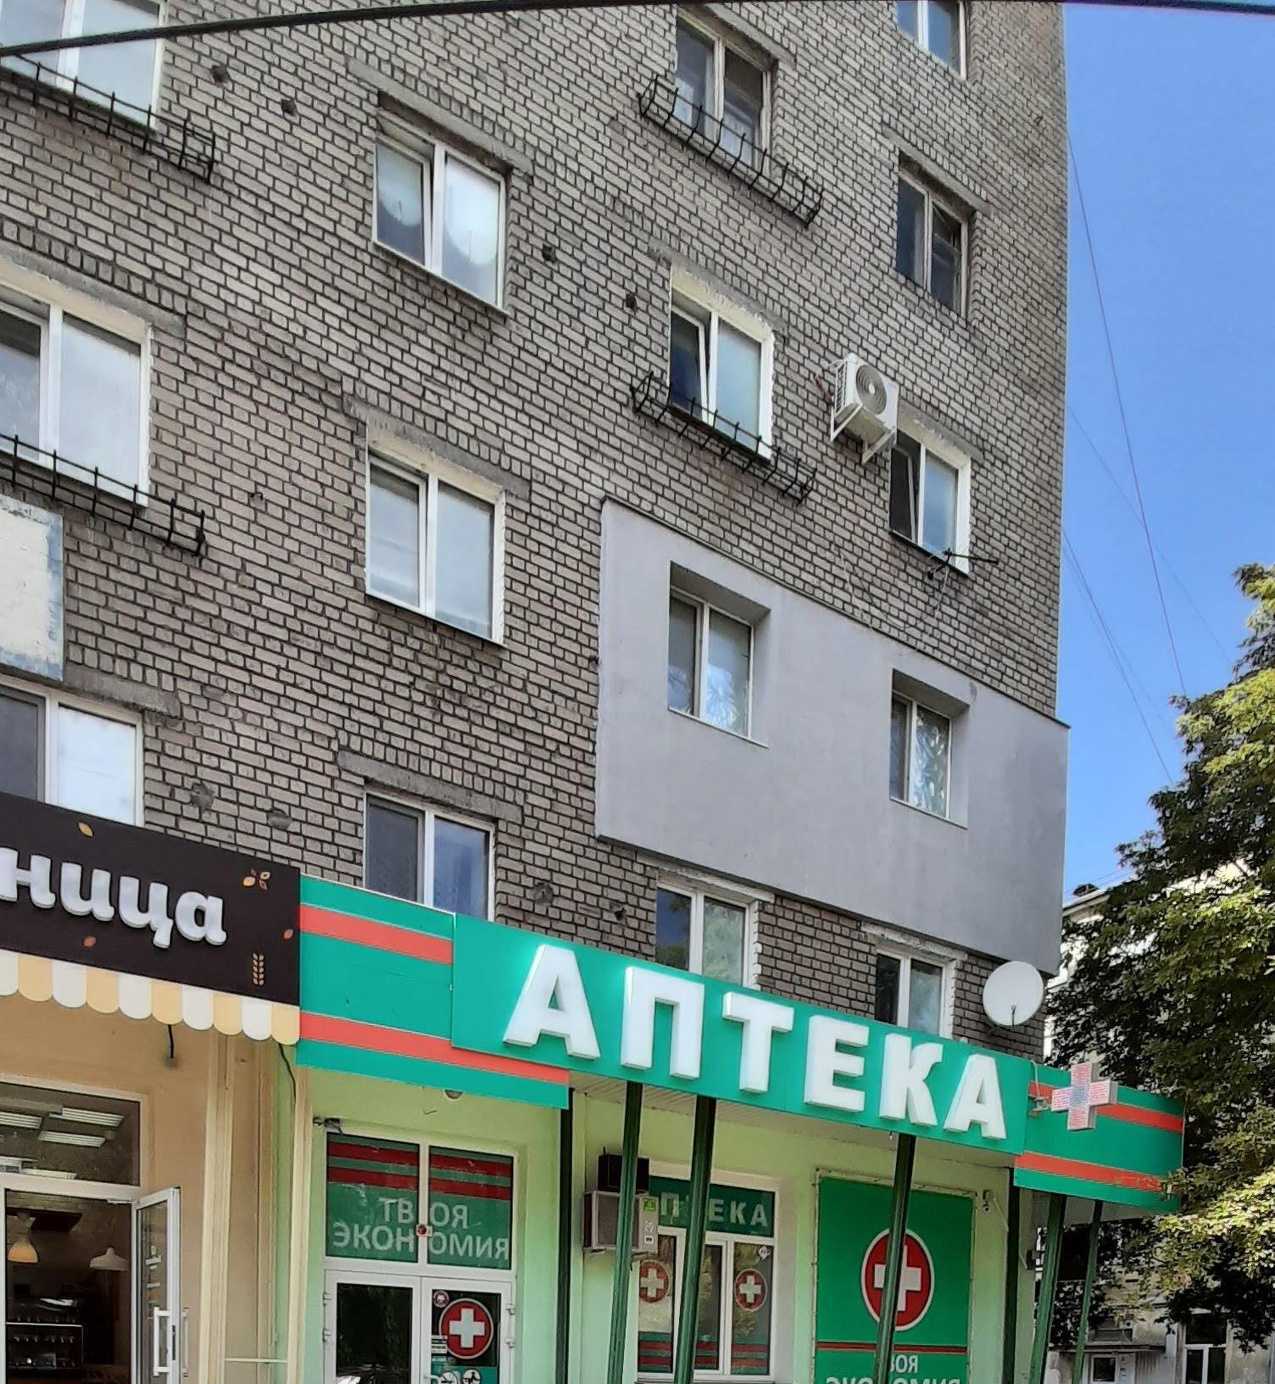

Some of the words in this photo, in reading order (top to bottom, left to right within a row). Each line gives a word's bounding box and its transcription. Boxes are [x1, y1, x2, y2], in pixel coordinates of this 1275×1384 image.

[503, 943, 1008, 1140] АПТЕКА
[379, 1197, 468, 1230] ТВОЯ
[332, 1221, 509, 1260] ЭКОНОМИЯ
